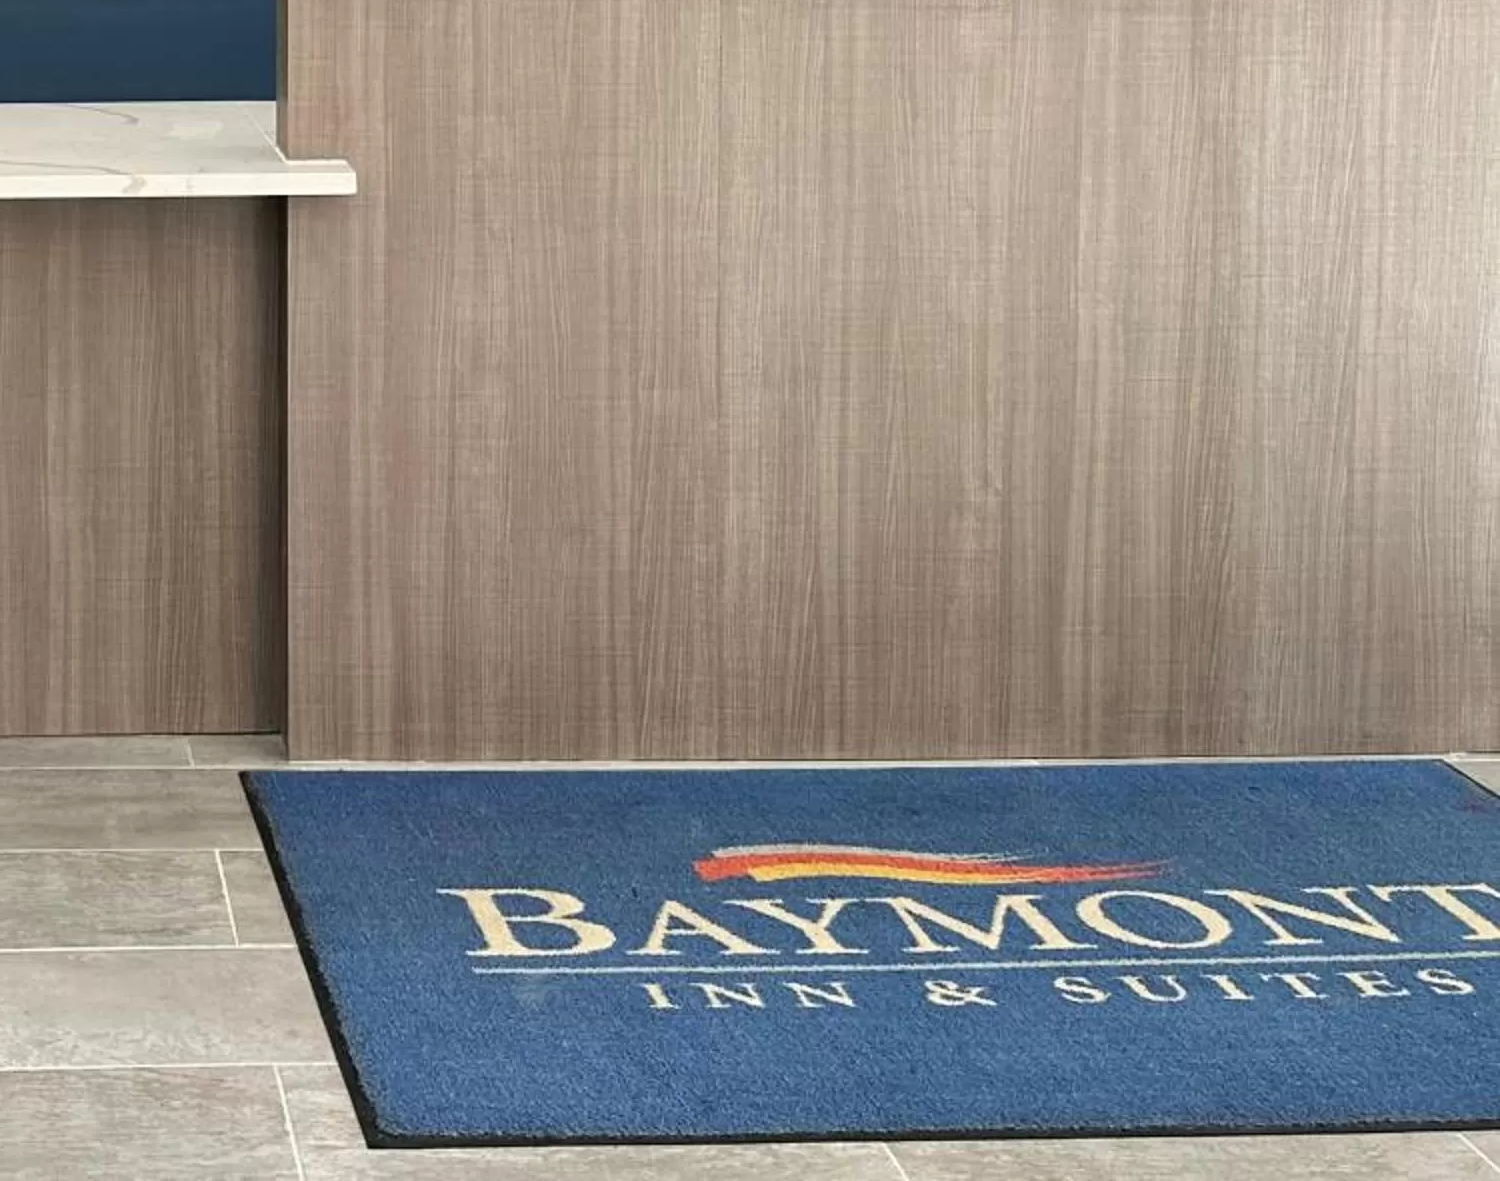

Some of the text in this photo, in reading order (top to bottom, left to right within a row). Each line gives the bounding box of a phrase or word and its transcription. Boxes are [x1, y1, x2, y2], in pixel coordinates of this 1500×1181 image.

[436, 882, 1500, 959] BAYMONT
[643, 967, 1476, 1010] INN & SUITES
